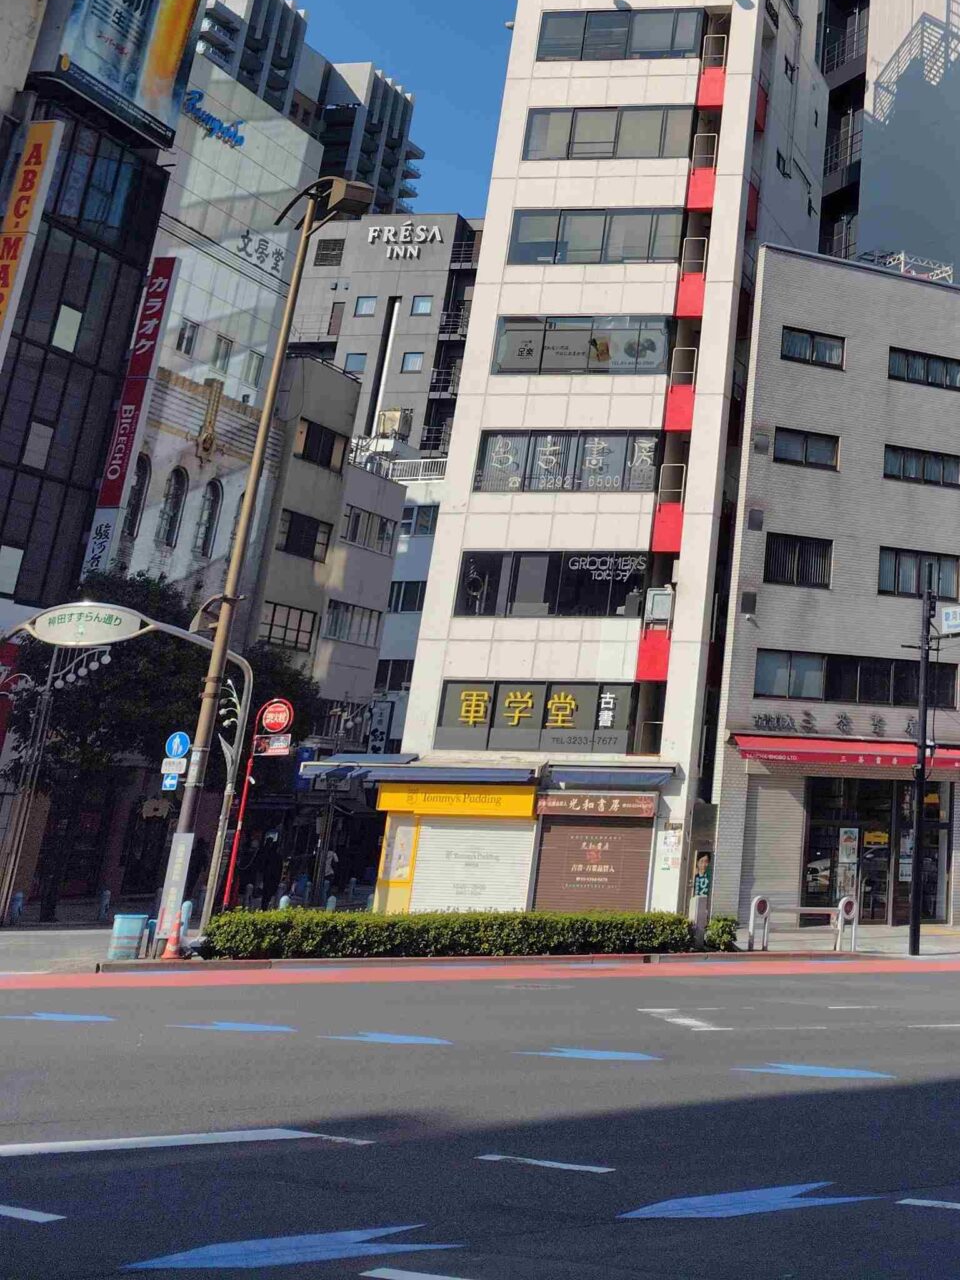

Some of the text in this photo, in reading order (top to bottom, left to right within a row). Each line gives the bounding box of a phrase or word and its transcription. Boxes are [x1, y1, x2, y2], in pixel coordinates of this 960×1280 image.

[111, 8, 126, 27] 生
[236, 230, 285, 273] 文房堂
[386, 245, 420, 260] INN
[135, 275, 170, 356] カラオケ
[120, 405, 136, 434] BIG
[106, 436, 128, 480] ECHO
[48, 612, 122, 627] 神田すずらん通り
[459, 691, 577, 727] 軍学堂
[598, 692, 616, 727] 古書
[552, 737, 565, 745] TEL
[463, 793, 502, 805] Pudding
